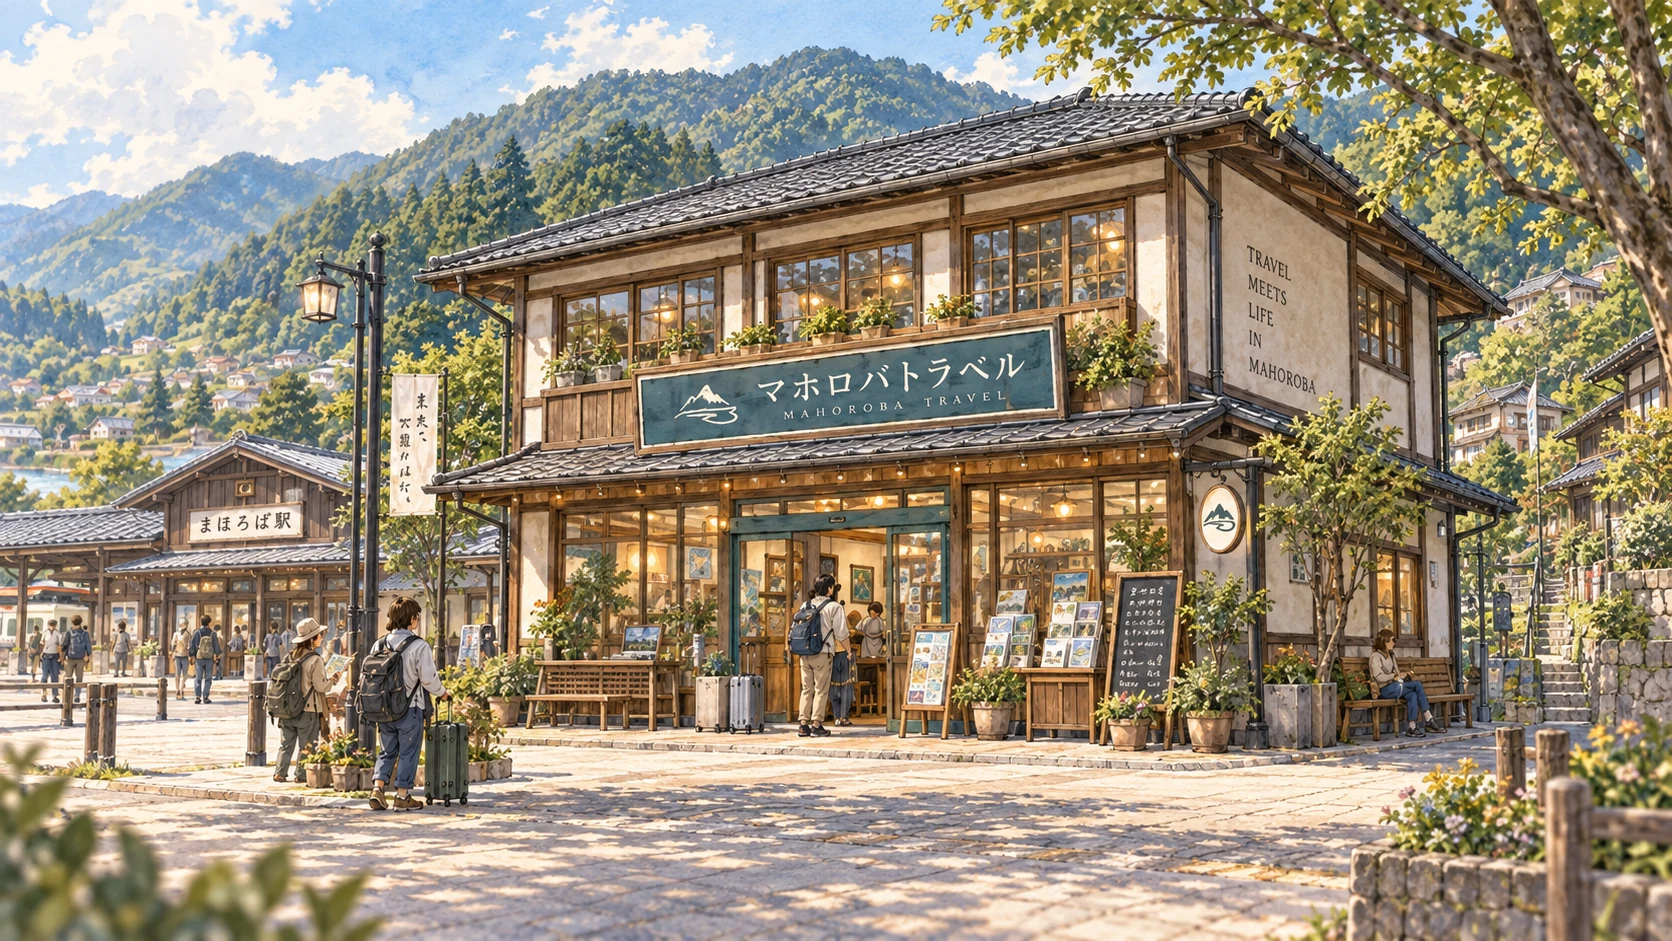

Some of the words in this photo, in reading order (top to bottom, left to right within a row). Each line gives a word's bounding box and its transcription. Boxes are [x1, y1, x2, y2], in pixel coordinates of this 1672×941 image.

[1247, 245, 1291, 281] TRAVEL
[1248, 274, 1287, 306] MEETS
[1248, 302, 1274, 327] LIFE
[1249, 329, 1262, 349] IN
[757, 353, 1026, 403] マホロバトラベル
[1249, 356, 1317, 395] MAHOROBA
[784, 401, 903, 420] MAHOROBA
[924, 390, 1006, 407] TRAVEL
[200, 511, 291, 533] まほろば駅
